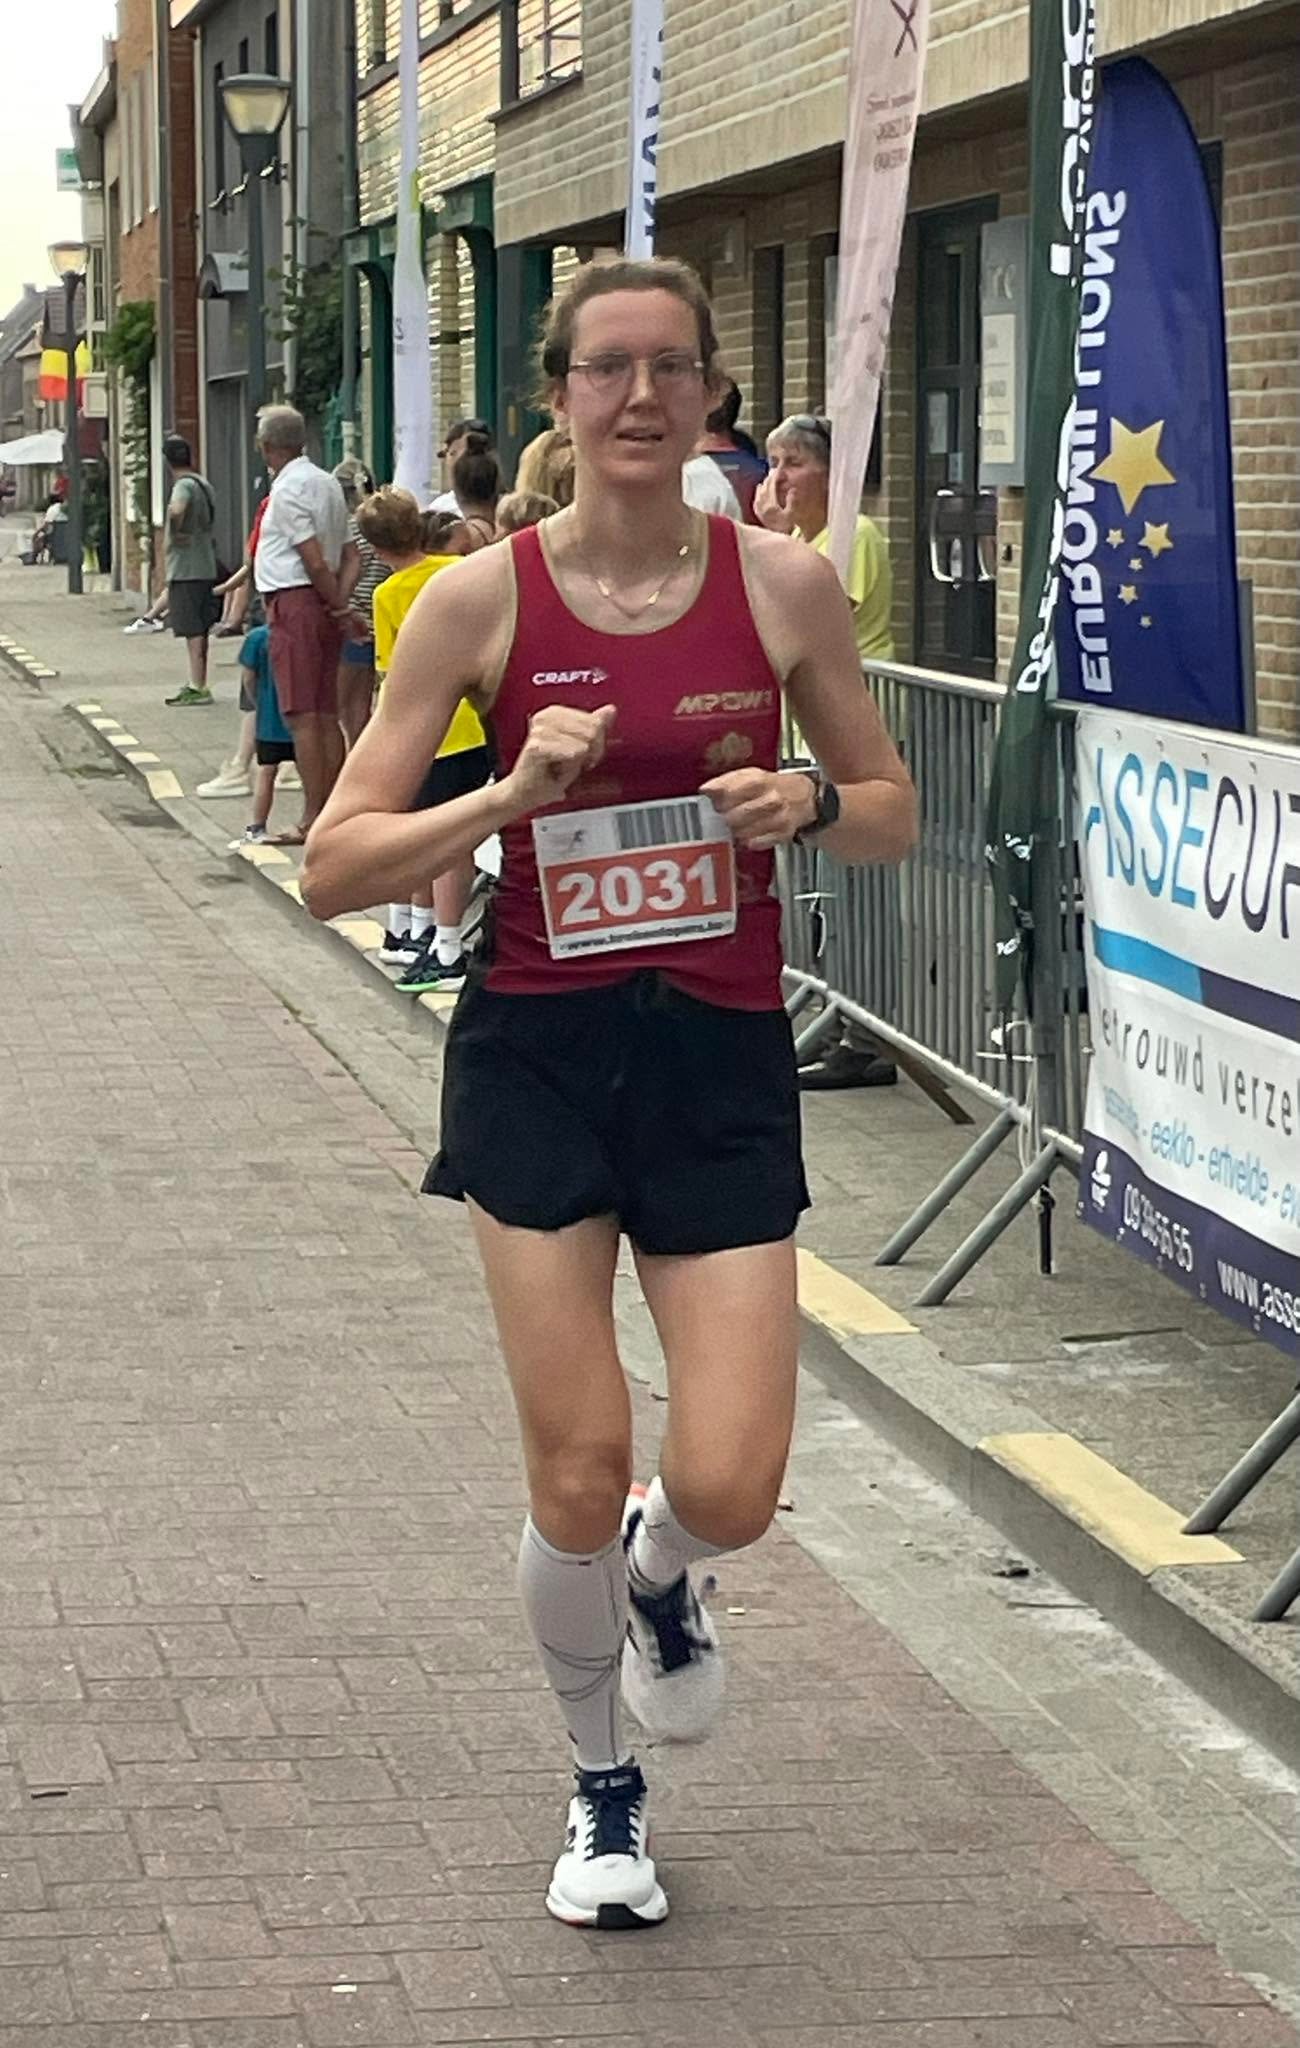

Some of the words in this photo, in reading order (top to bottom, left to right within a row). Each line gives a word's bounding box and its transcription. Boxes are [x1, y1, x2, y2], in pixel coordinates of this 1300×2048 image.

[532, 670, 592, 686] CRAFT
[557, 854, 719, 926] 2031
[1103, 1009, 1204, 1094] etrouwd
[1218, 1060, 1300, 1136] verze
